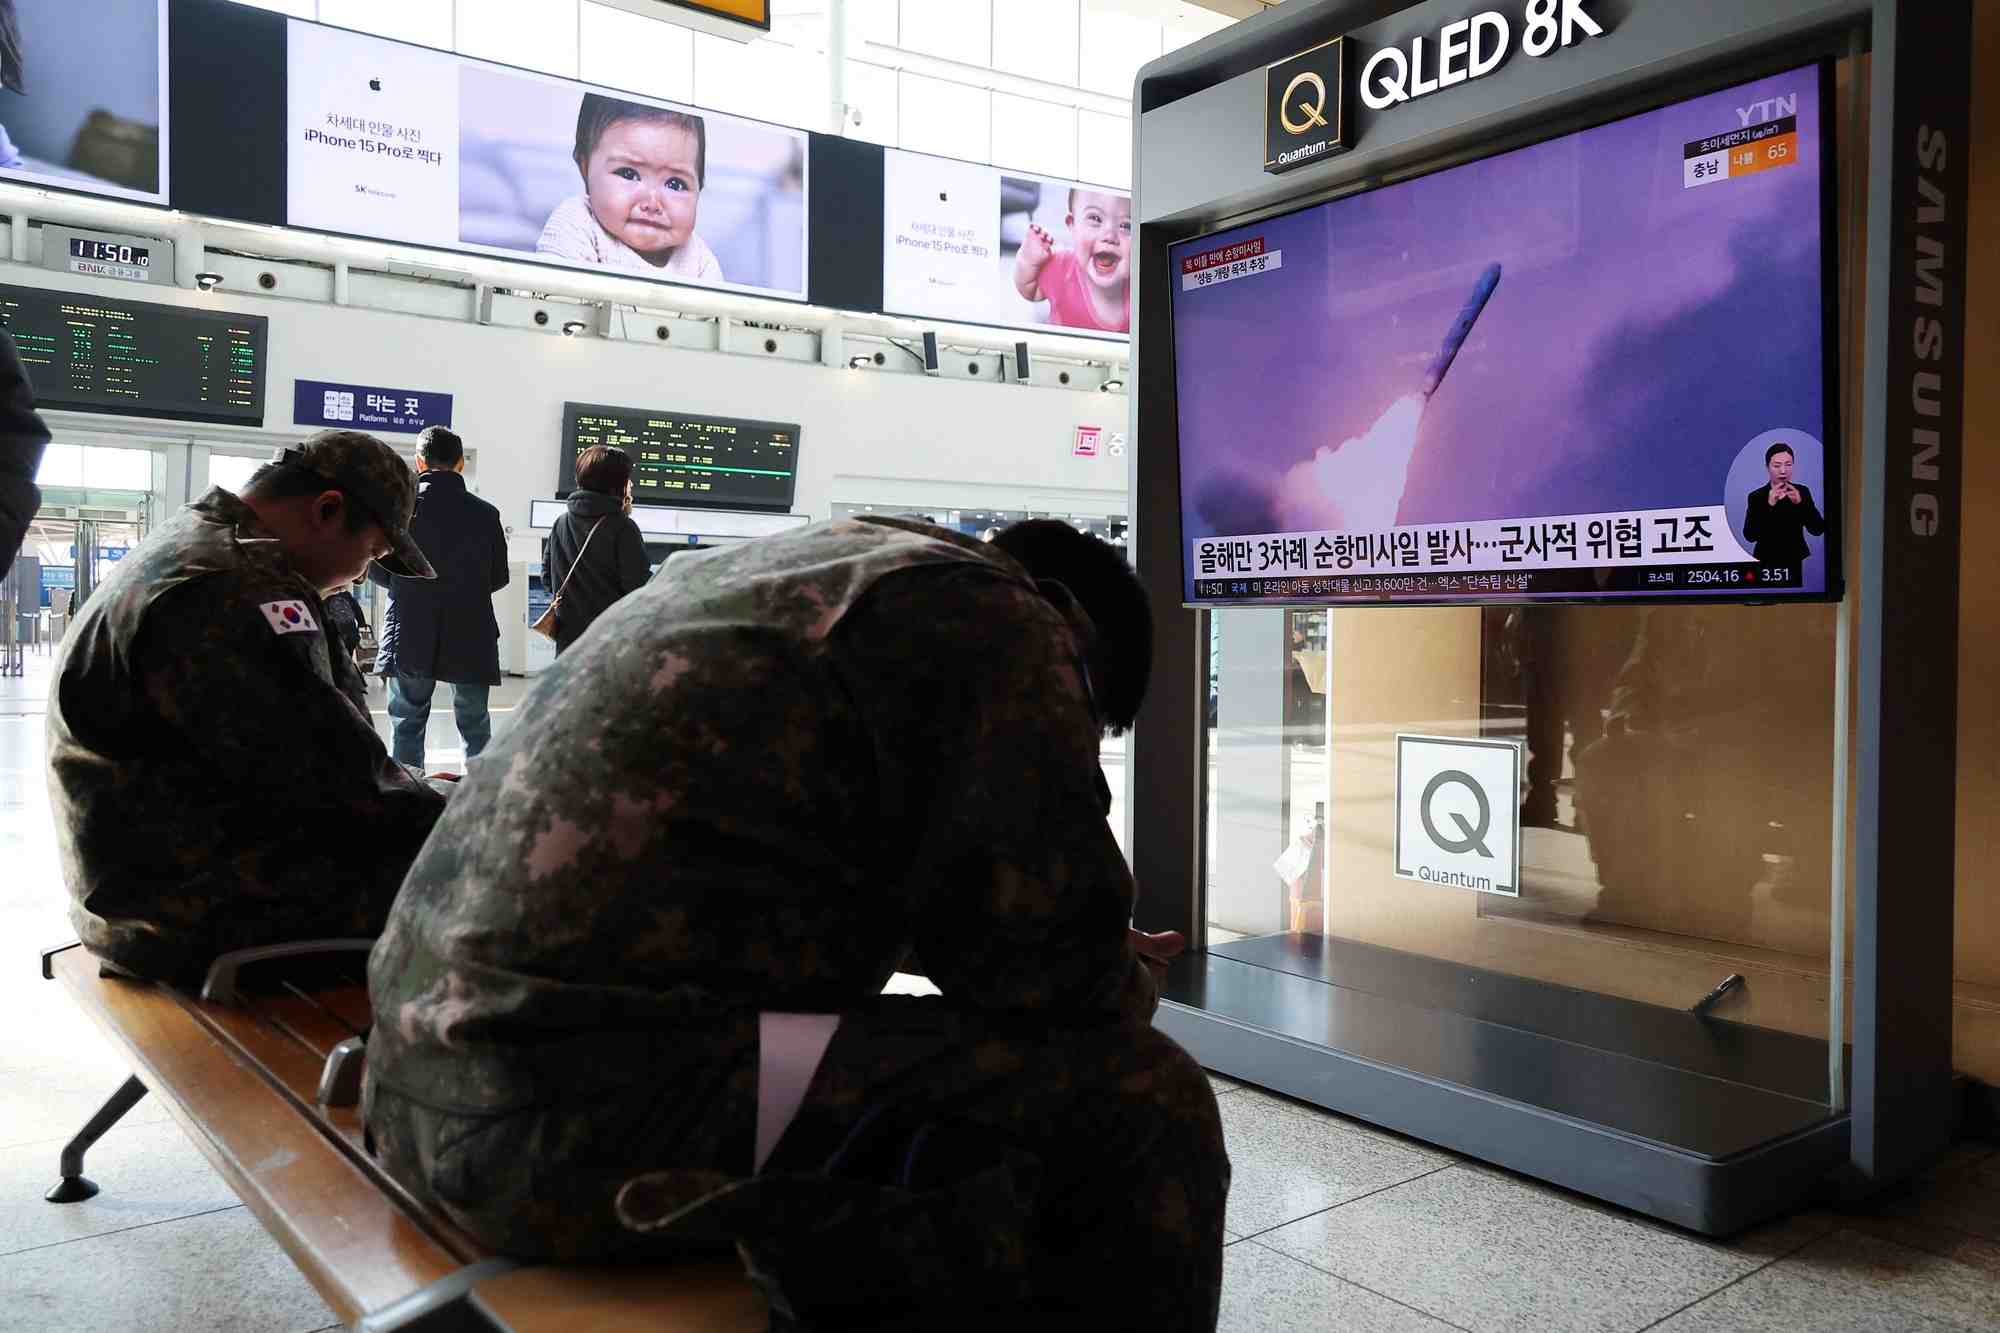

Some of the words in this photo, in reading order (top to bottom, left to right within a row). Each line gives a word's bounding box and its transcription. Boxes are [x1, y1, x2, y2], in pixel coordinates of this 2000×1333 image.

[1360, 11, 1510, 110] QLED
[1522, 0, 1604, 57] 8K
[1281, 71, 1328, 135] Q
[1736, 93, 1797, 126] YTN
[326, 112, 366, 132] 차세대
[368, 120, 393, 137] 인물
[397, 127, 421, 143] 사진
[304, 128, 356, 149] iPhone
[359, 139, 375, 153] 15
[377, 142, 414, 160] Pro로
[1278, 140, 1326, 165] Quantum
[1700, 130, 1751, 153] 초미세먼지
[1767, 143, 1788, 160] 65
[1694, 160, 1719, 178] 충남
[896, 234, 931, 249] iPhone
[1209, 249, 1224, 265] 만에
[1224, 239, 1261, 261] 순항미사일
[137, 256, 149, 266] 10
[1231, 261, 1248, 276] 목적
[1909, 124, 1947, 537] SAMSUNG
[367, 394, 397, 413] 타는
[404, 397, 419, 416] 곳
[359, 413, 388, 424] Platforms
[1199, 540, 1252, 574] 올해만
[1258, 537, 1308, 571] 3차례
[1313, 530, 1420, 570] 순항미사일
[1586, 517, 1642, 561] 위협
[1652, 515, 1714, 554] 고조
[1200, 582, 1223, 595] 11:50
[1231, 582, 1248, 593] 국제
[1252, 581, 1261, 593] 미
[1263, 580, 1290, 594] 온라인
[1291, 580, 1311, 594] 아동
[1352, 577, 1373, 592] 신고
[1647, 573, 1674, 584] 코스피
[1687, 569, 1740, 584] 2504.16
[1761, 568, 1790, 582] 3.51
[1420, 769, 1495, 859] Q
[1418, 865, 1491, 891] Quantum
